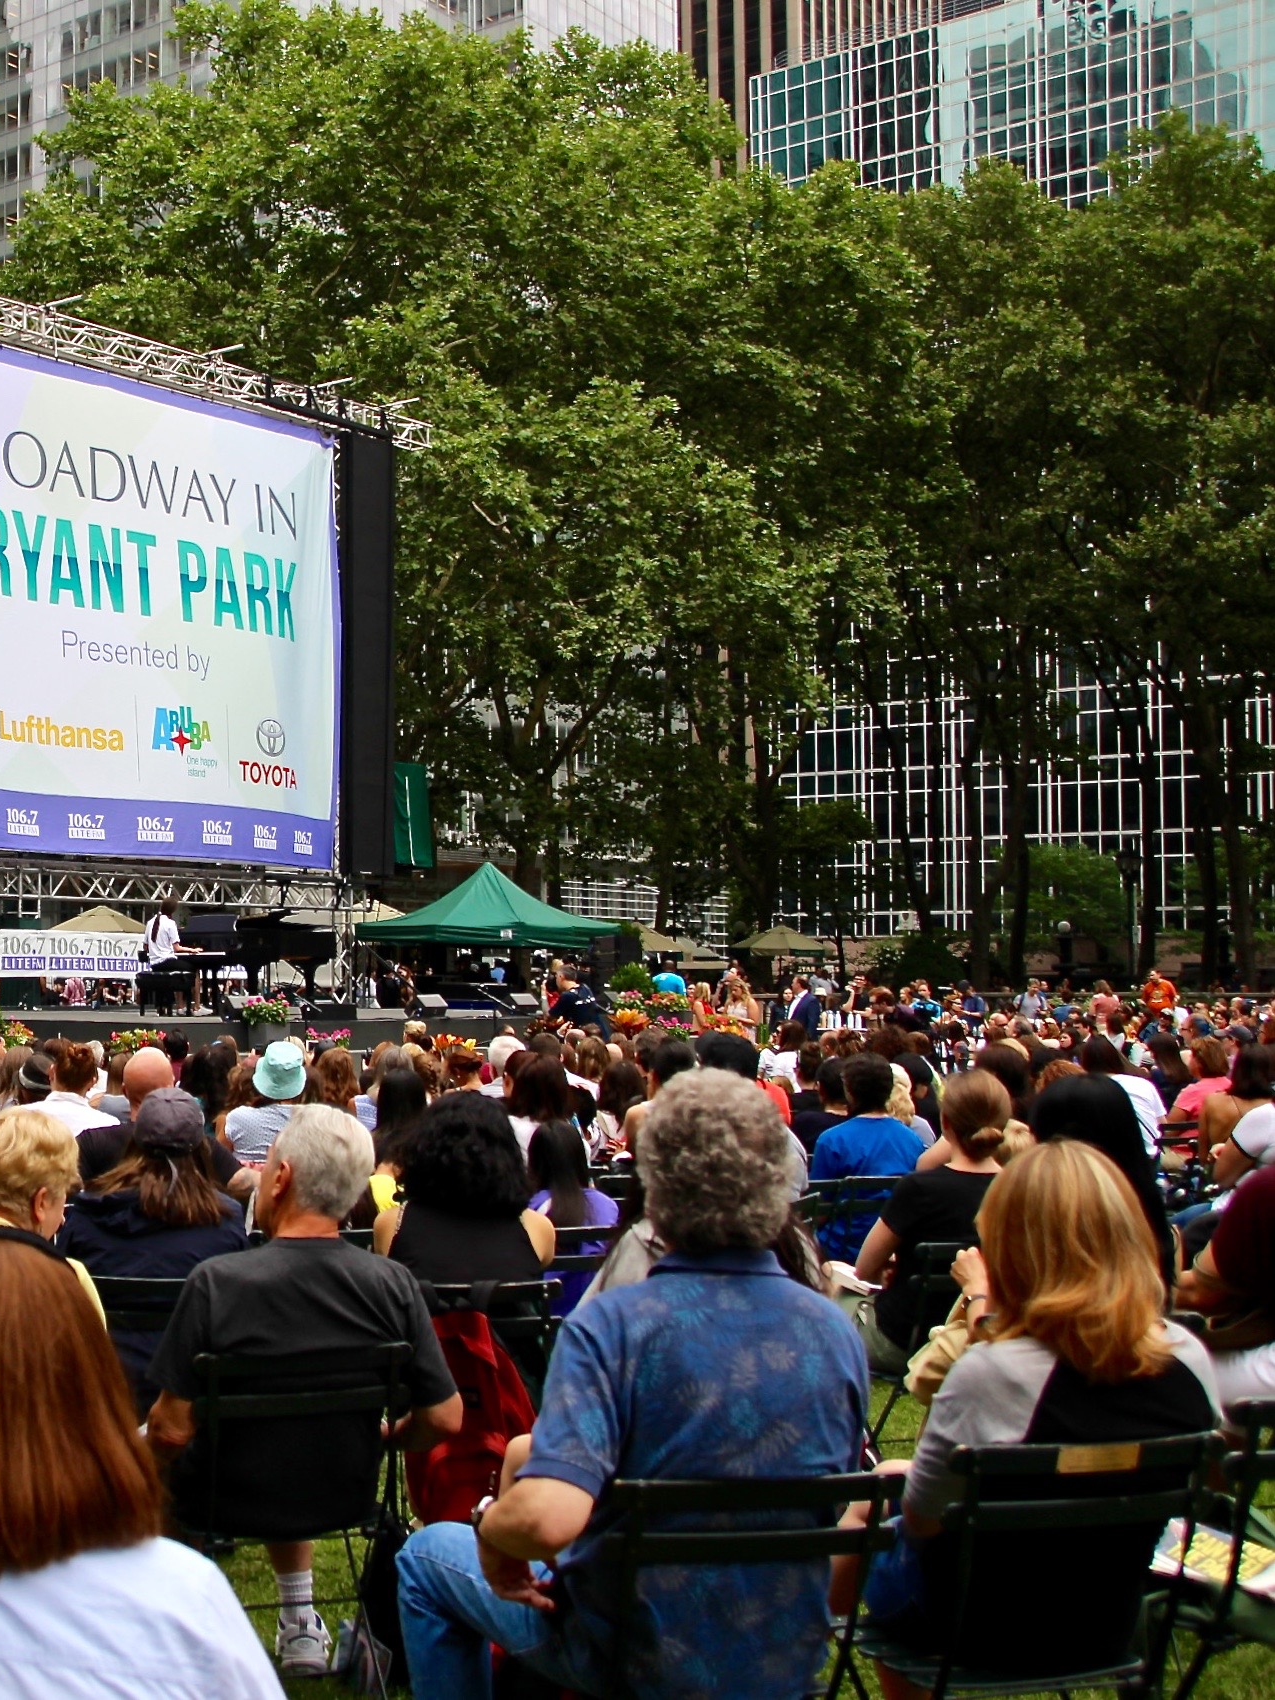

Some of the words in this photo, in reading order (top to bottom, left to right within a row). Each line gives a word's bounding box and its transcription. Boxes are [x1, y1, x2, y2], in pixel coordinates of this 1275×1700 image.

[255, 483, 296, 541] IN
[177, 539, 297, 642] PARK
[61, 630, 179, 670] Presented
[187, 644, 211, 681] by
[151, 705, 212, 751] ARUBA
[186, 755, 199, 766] One
[199, 756, 218, 769] happy
[187, 768, 206, 778] island
[239, 760, 298, 790] TOYOTA
[6, 808, 38, 825] 106.7
[68, 813, 104, 829] 106.7
[136, 816, 173, 832] 106.7
[202, 820, 232, 835] 106.7
[254, 824, 277, 839] 106.7
[294, 830, 312, 844] 106.7
[2, 937, 46, 955] 106.7
[49, 937, 93, 956] 106.7
[97, 939, 139, 957] 106.7
